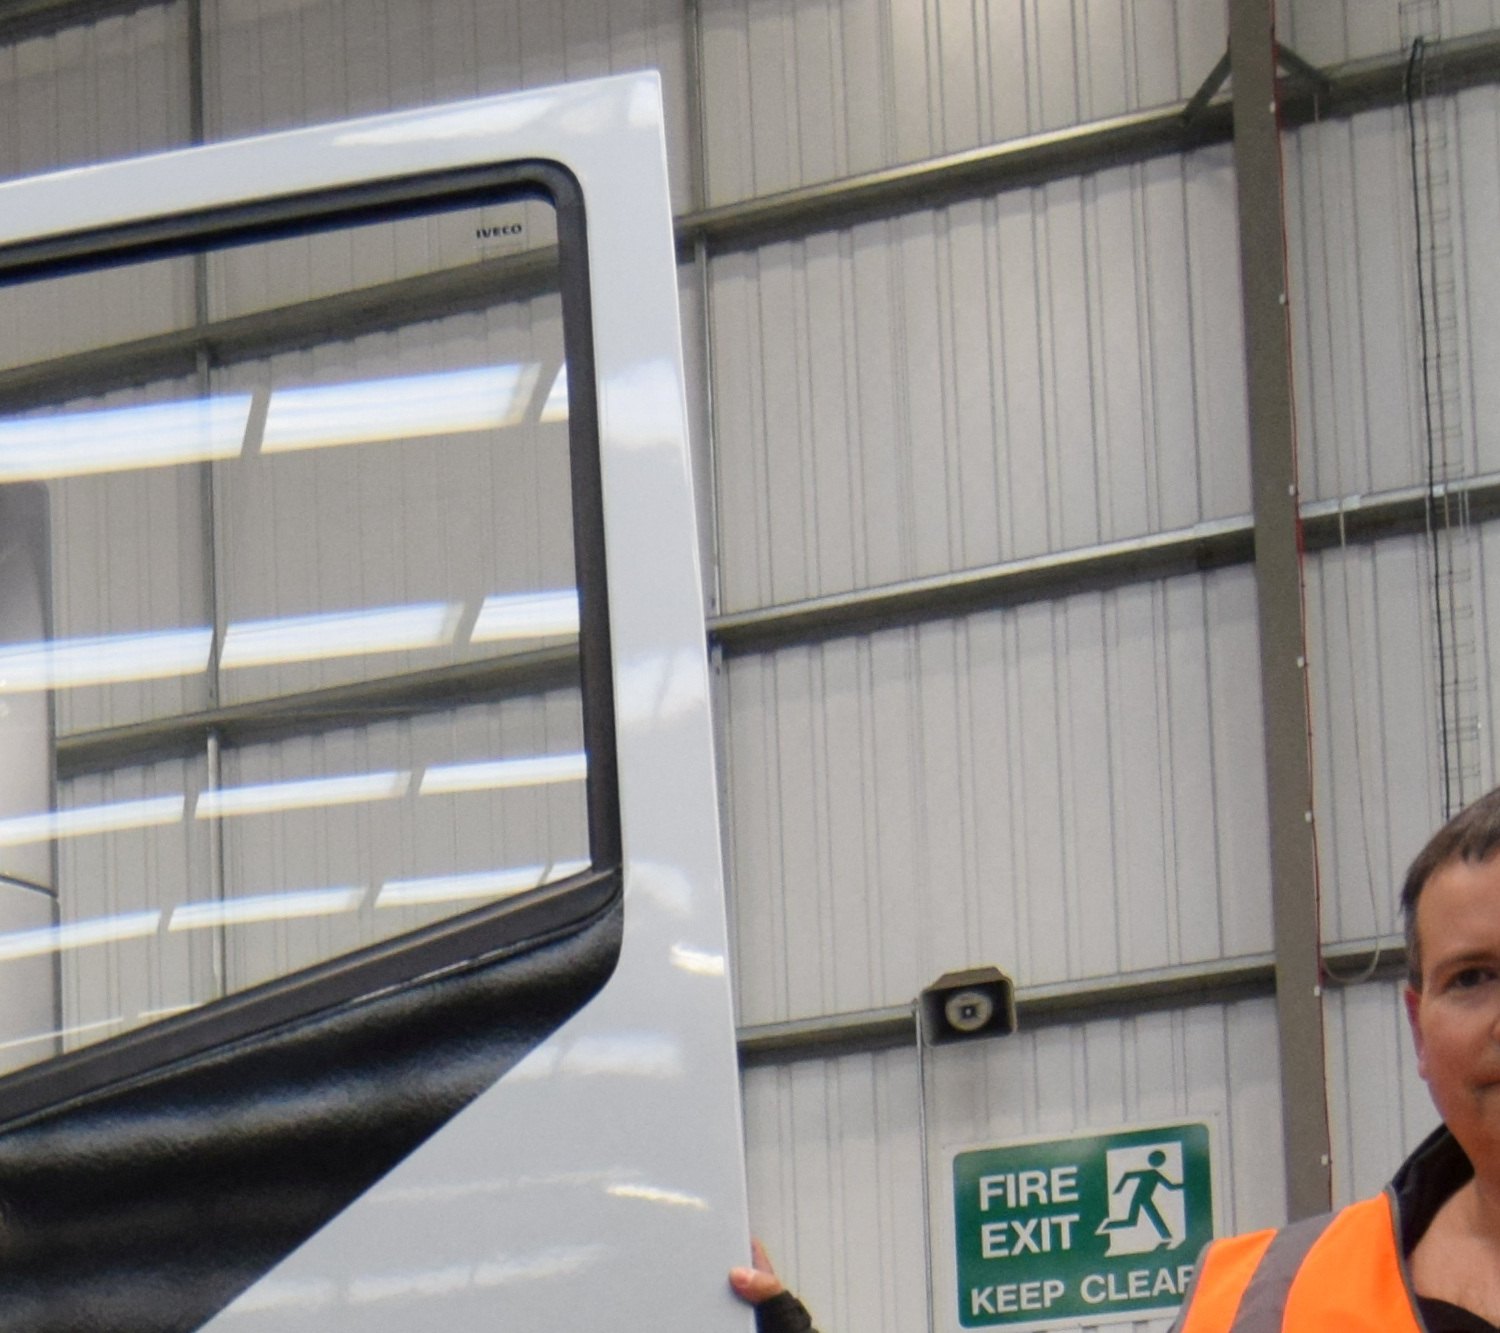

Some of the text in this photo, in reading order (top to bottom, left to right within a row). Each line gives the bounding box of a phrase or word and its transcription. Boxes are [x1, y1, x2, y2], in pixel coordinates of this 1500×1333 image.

[475, 223, 523, 239] IVECO
[979, 1165, 1079, 1212] FIRE
[980, 1213, 1080, 1260] EXIT
[970, 1279, 1065, 1316] KEEP
